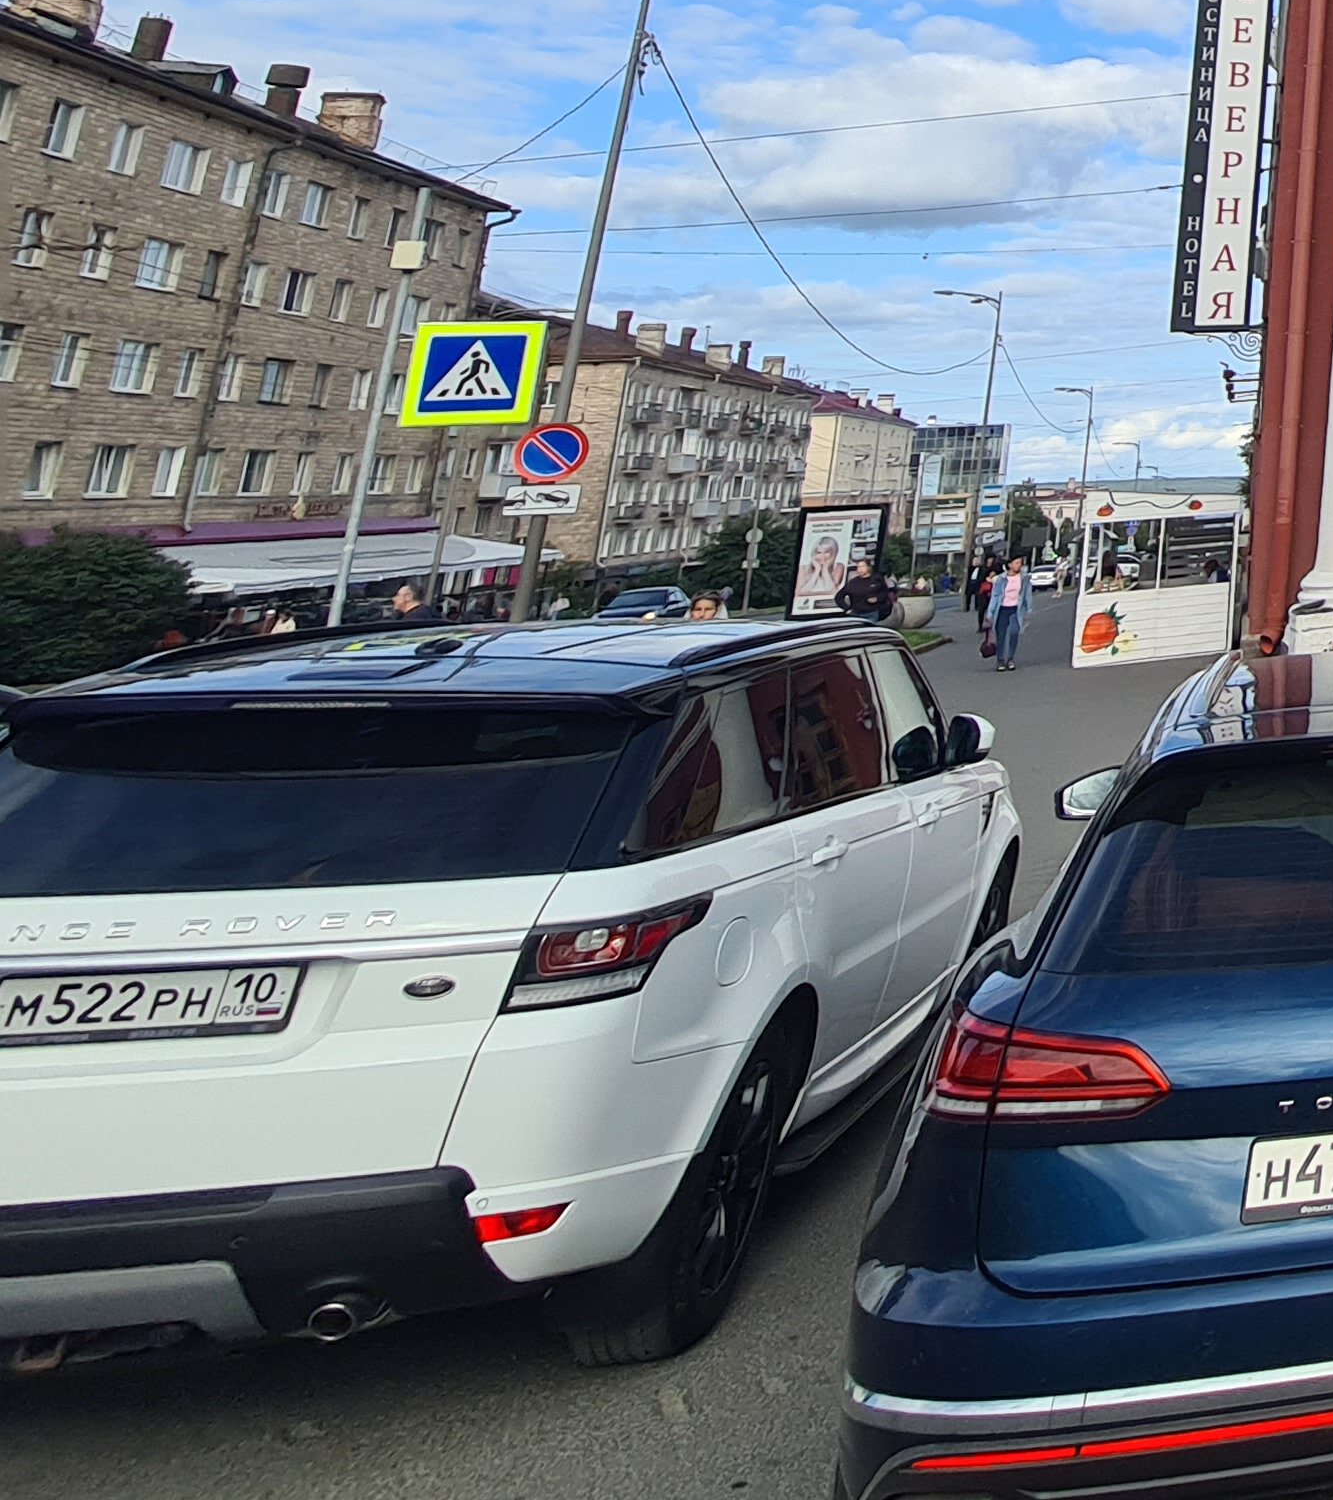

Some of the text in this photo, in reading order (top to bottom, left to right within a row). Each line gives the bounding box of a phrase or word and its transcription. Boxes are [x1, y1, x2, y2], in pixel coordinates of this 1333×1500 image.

[1180, 216, 1201, 318] HOTEL
[179, 910, 398, 936] ROVER
[4, 972, 278, 1028] М522РН 10
[219, 1004, 255, 1017] RUS
